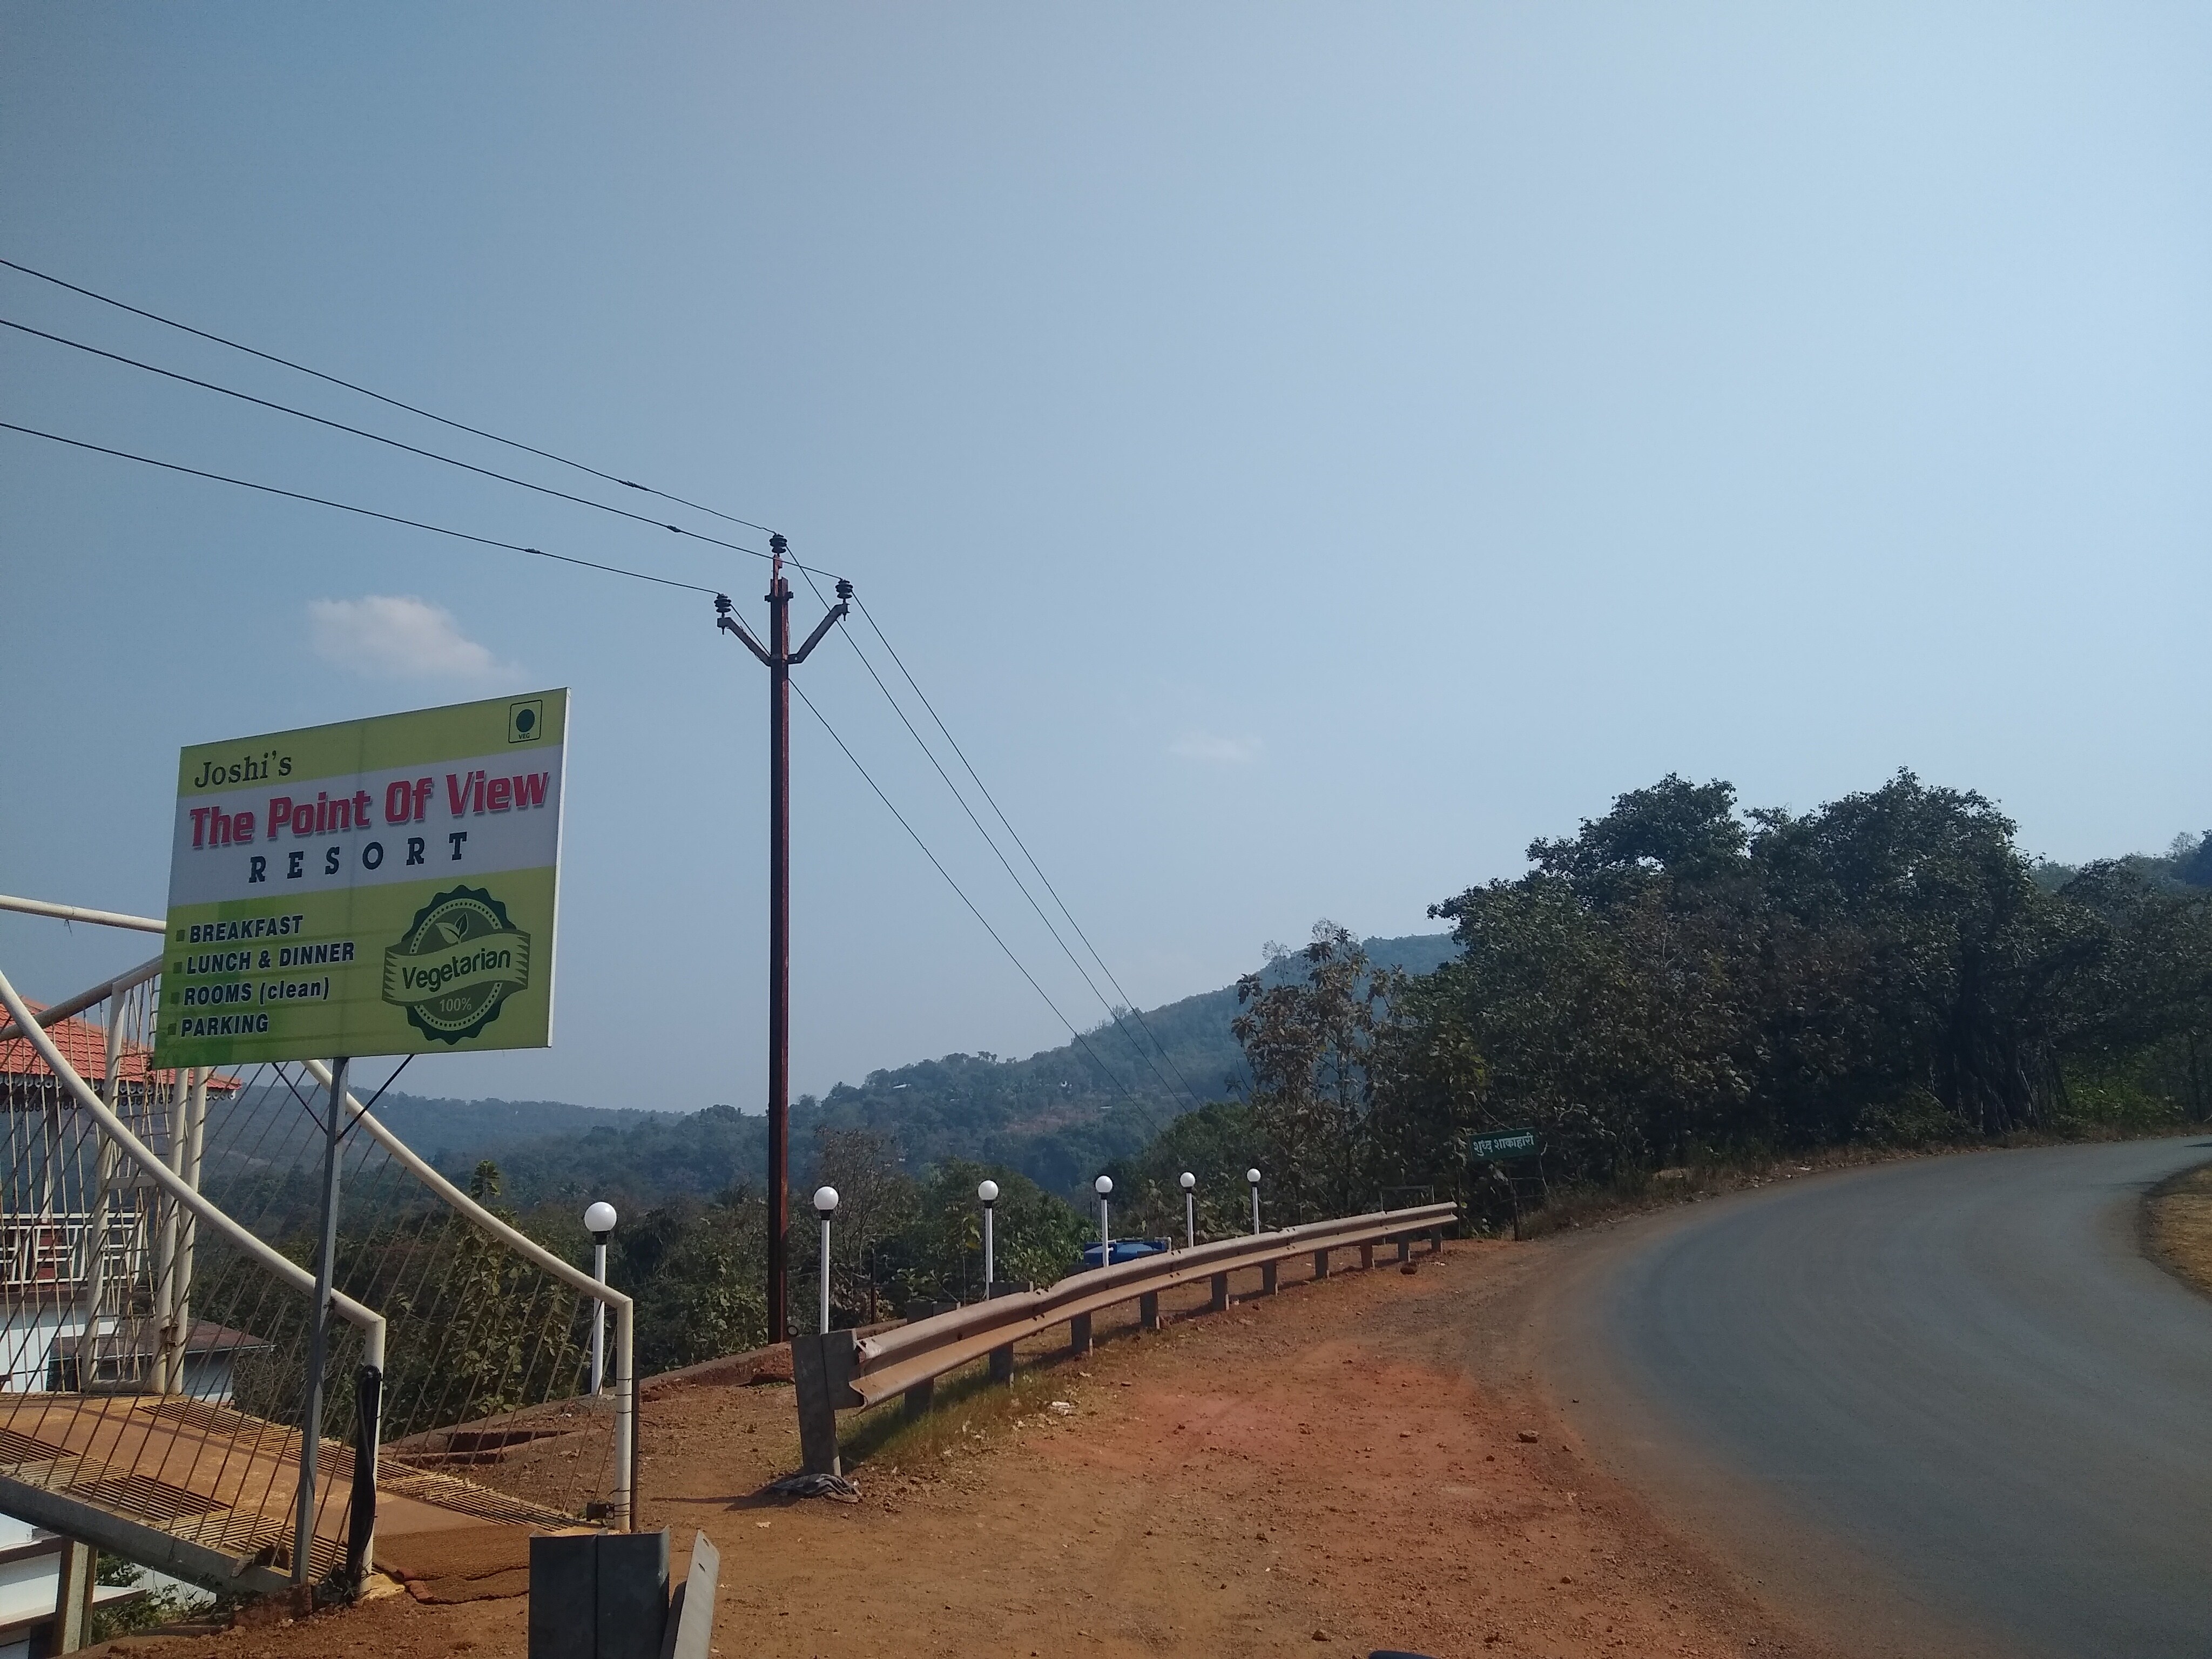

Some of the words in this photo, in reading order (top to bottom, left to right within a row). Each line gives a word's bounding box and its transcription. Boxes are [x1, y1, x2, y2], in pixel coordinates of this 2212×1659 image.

[194, 751, 292, 788] Joshi's
[190, 806, 254, 848] The
[267, 790, 372, 841] Point
[385, 777, 434, 825] Of
[446, 770, 549, 817] View
[248, 832, 468, 883] RESORT
[190, 915, 303, 943] BREAKFAST
[186, 953, 251, 974] LUNCH
[258, 950, 270, 968] &
[279, 942, 354, 966] DINNER
[402, 947, 511, 992] Vegetarian
[184, 984, 252, 1006] ROOMS
[259, 977, 330, 1005] (clean)
[439, 997, 473, 1013] 100%
[181, 1014, 268, 1037] PARKING
[1494, 1132, 1534, 1150] शाकाहारी
